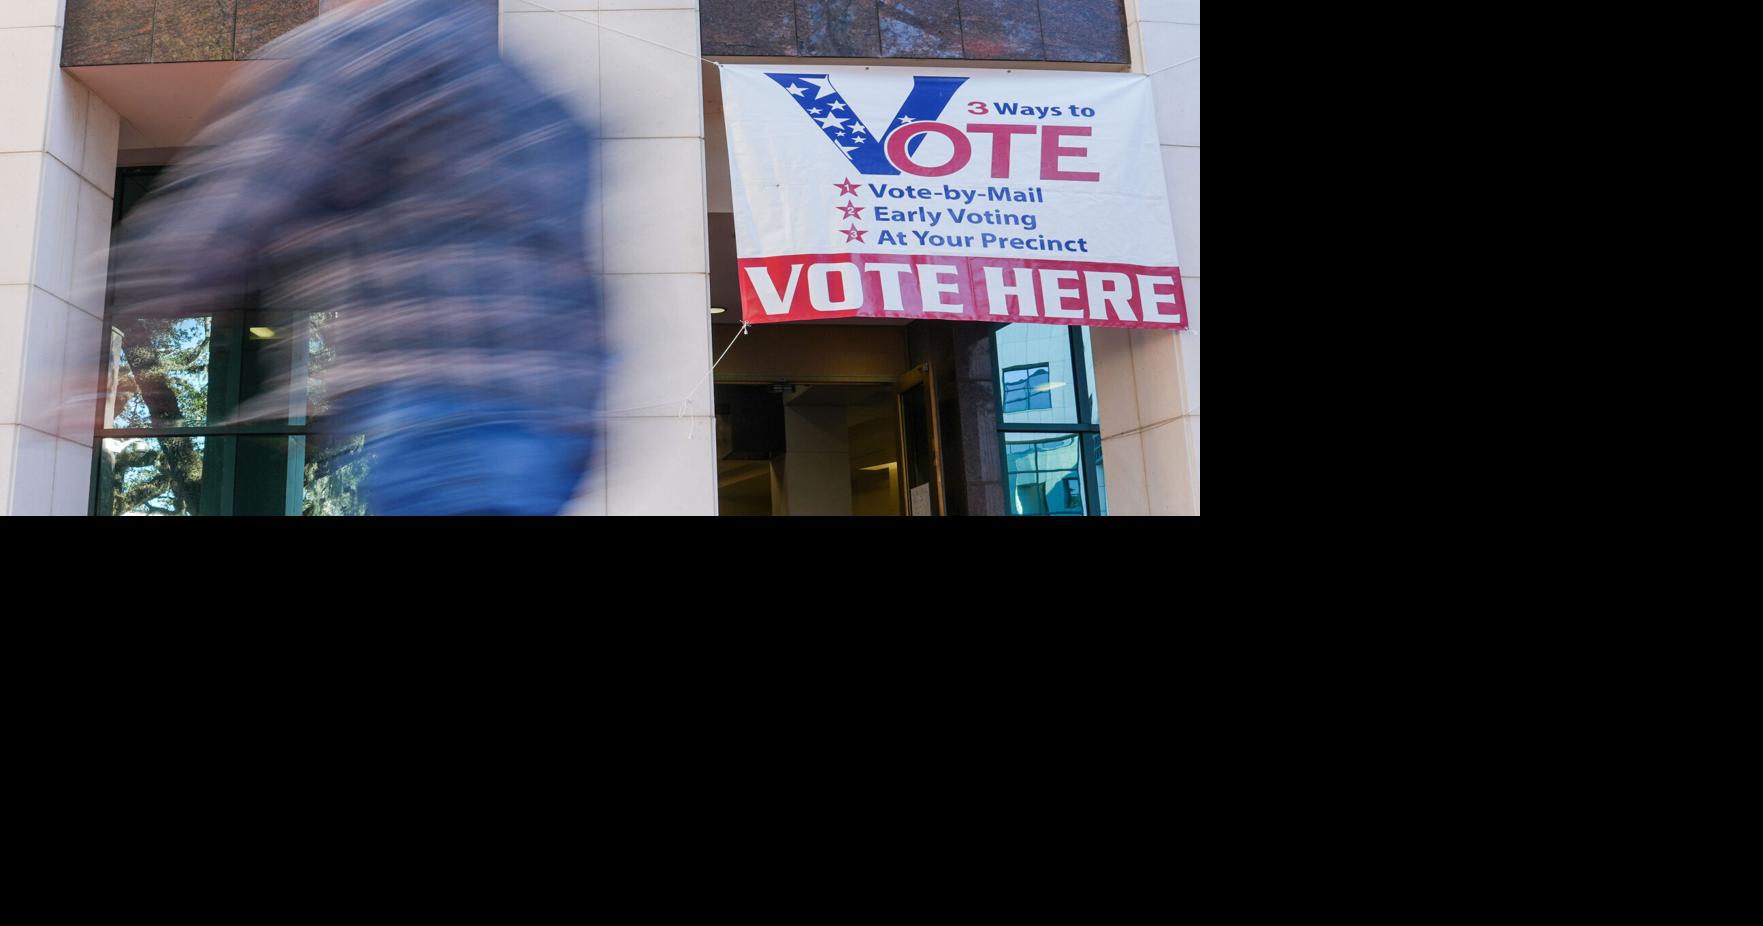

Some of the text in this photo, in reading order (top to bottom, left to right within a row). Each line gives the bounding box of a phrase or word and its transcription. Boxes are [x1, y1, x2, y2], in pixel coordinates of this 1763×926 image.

[967, 101, 1096, 118] 3 Ways to
[764, 72, 1101, 182] VOTE
[868, 183, 1044, 204] Vote-by-Mail
[874, 206, 942, 227] Early
[948, 208, 1037, 230] Voting
[878, 229, 908, 246] At
[912, 230, 974, 248] Your
[981, 232, 1089, 253] Precinct
[744, 261, 1181, 324] VOTE HERE
